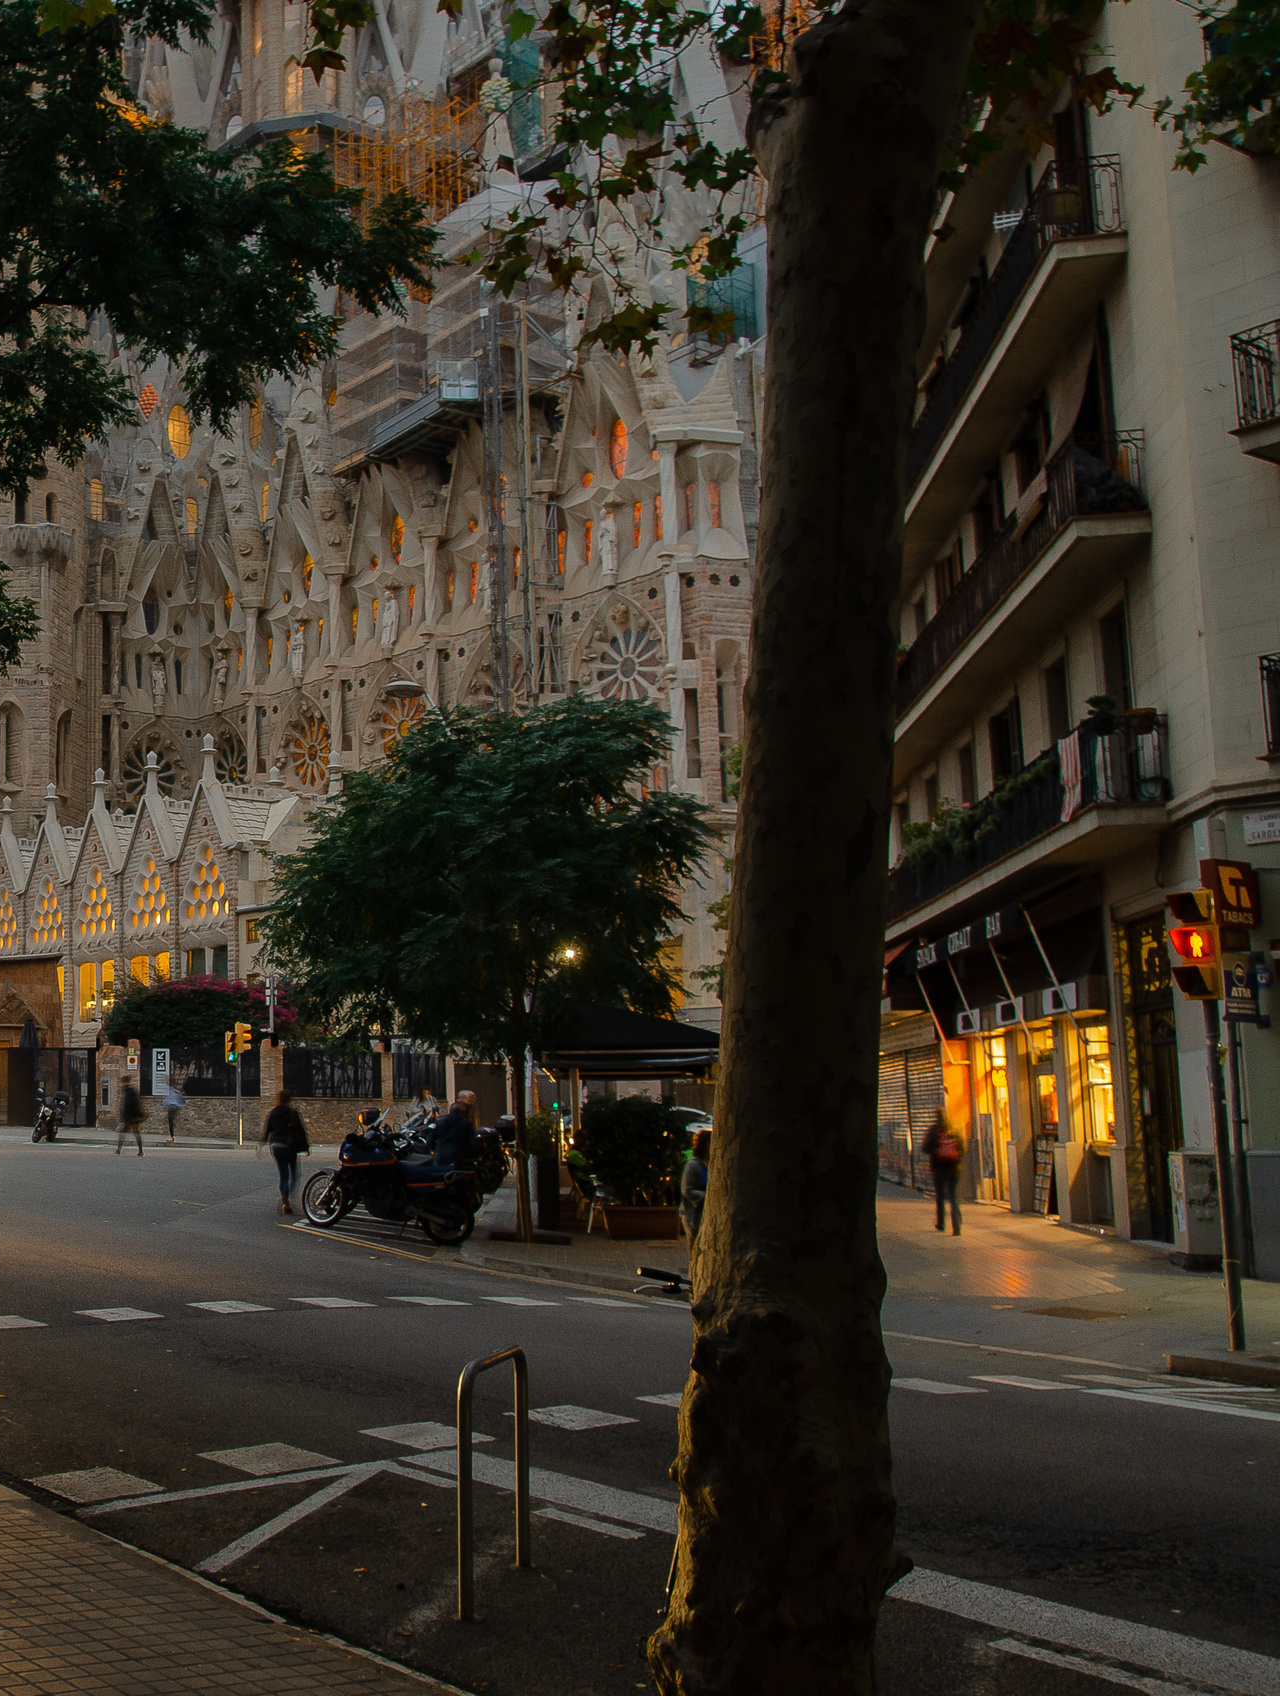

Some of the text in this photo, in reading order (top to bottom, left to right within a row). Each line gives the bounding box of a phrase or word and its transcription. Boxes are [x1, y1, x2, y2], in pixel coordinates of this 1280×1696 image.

[1222, 910, 1254, 924] TABACS
[985, 912, 1002, 939] BAR
[1231, 987, 1251, 998] ATM
